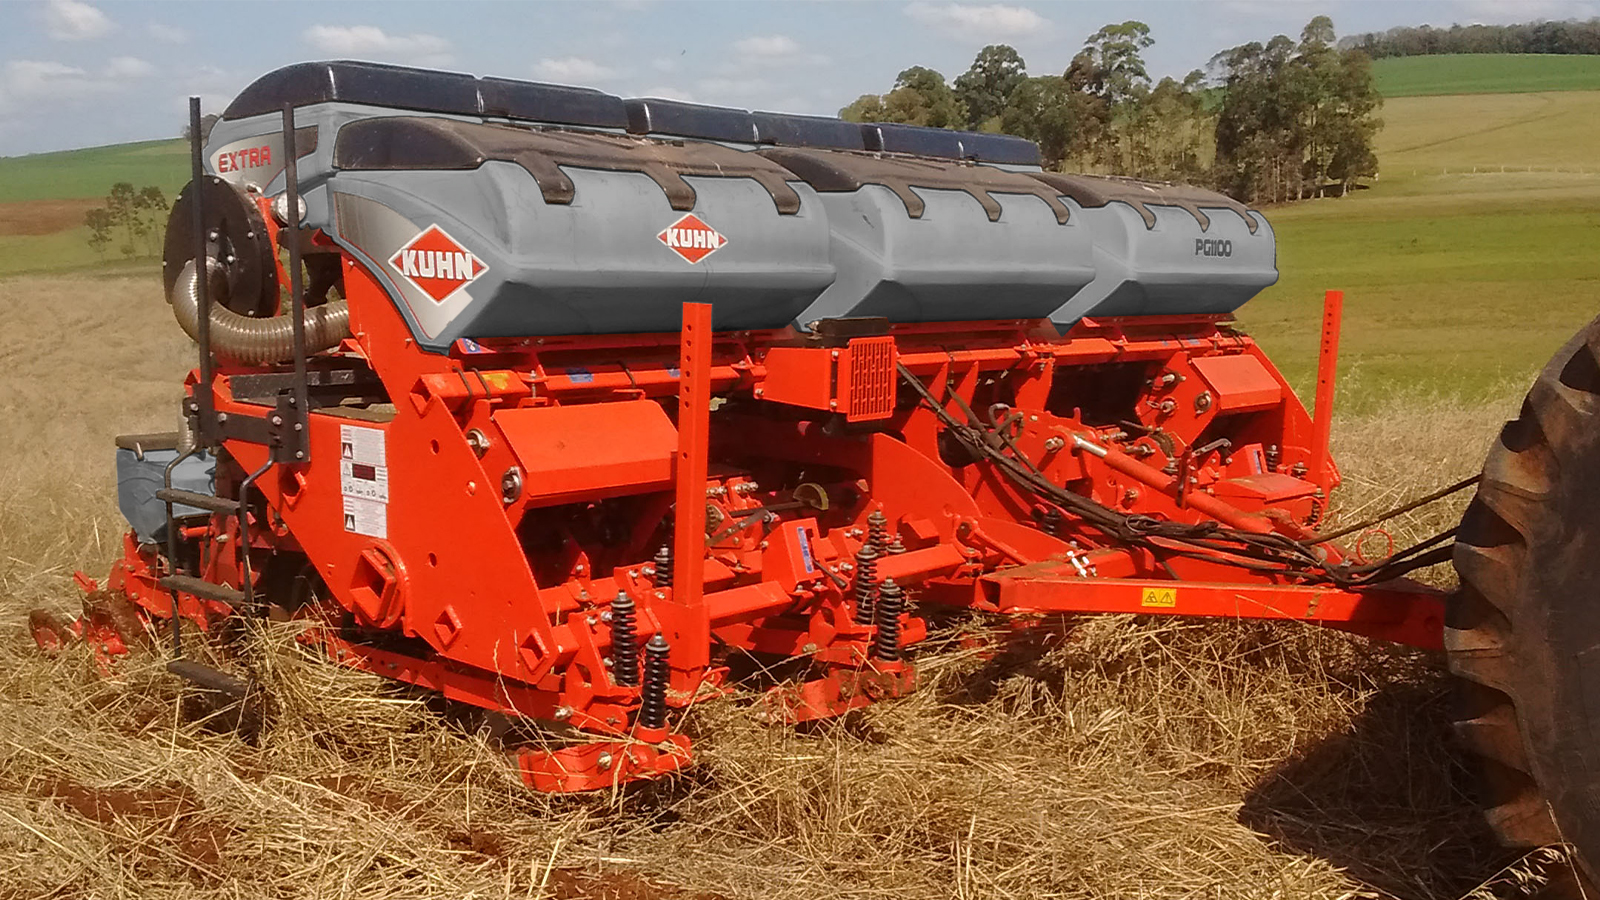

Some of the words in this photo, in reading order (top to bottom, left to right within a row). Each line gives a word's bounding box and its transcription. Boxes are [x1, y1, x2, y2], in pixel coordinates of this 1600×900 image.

[218, 145, 272, 173] EXTRA
[666, 228, 719, 249] KUHN
[1195, 238, 1232, 257] PG1100
[402, 249, 474, 280] KUHN
